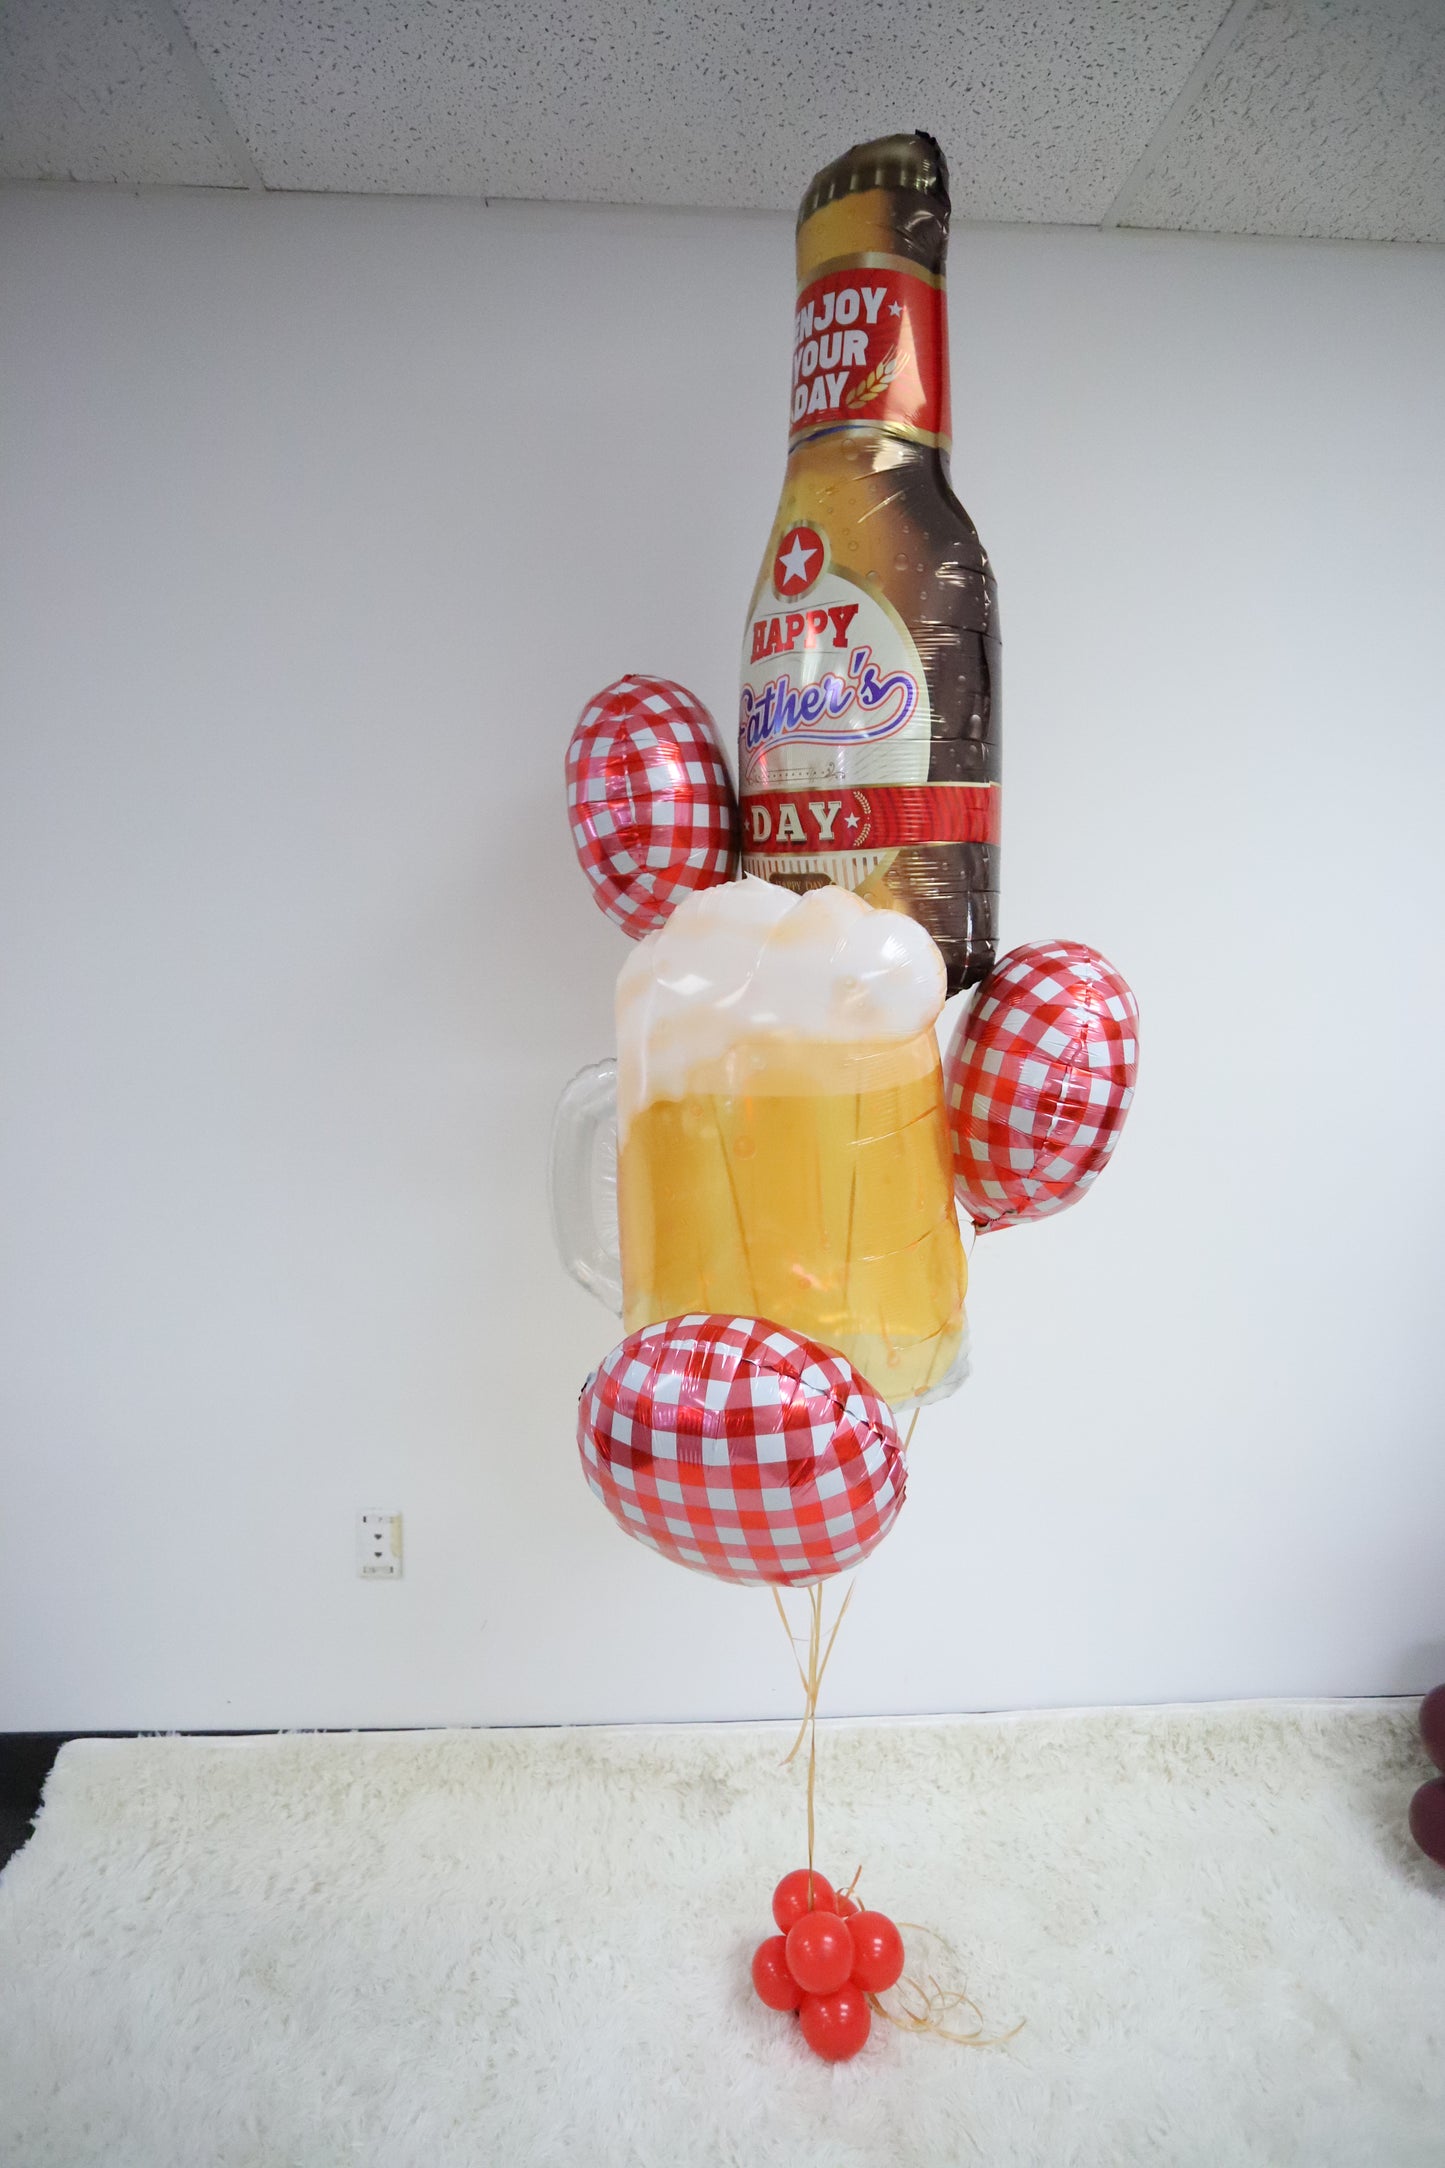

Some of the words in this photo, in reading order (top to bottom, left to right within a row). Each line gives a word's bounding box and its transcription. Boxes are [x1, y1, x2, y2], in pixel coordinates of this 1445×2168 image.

[795, 287, 888, 345] NJOY
[791, 371, 850, 423] DAY
[750, 603, 860, 665] HAPPY
[751, 801, 842, 843] DAY
